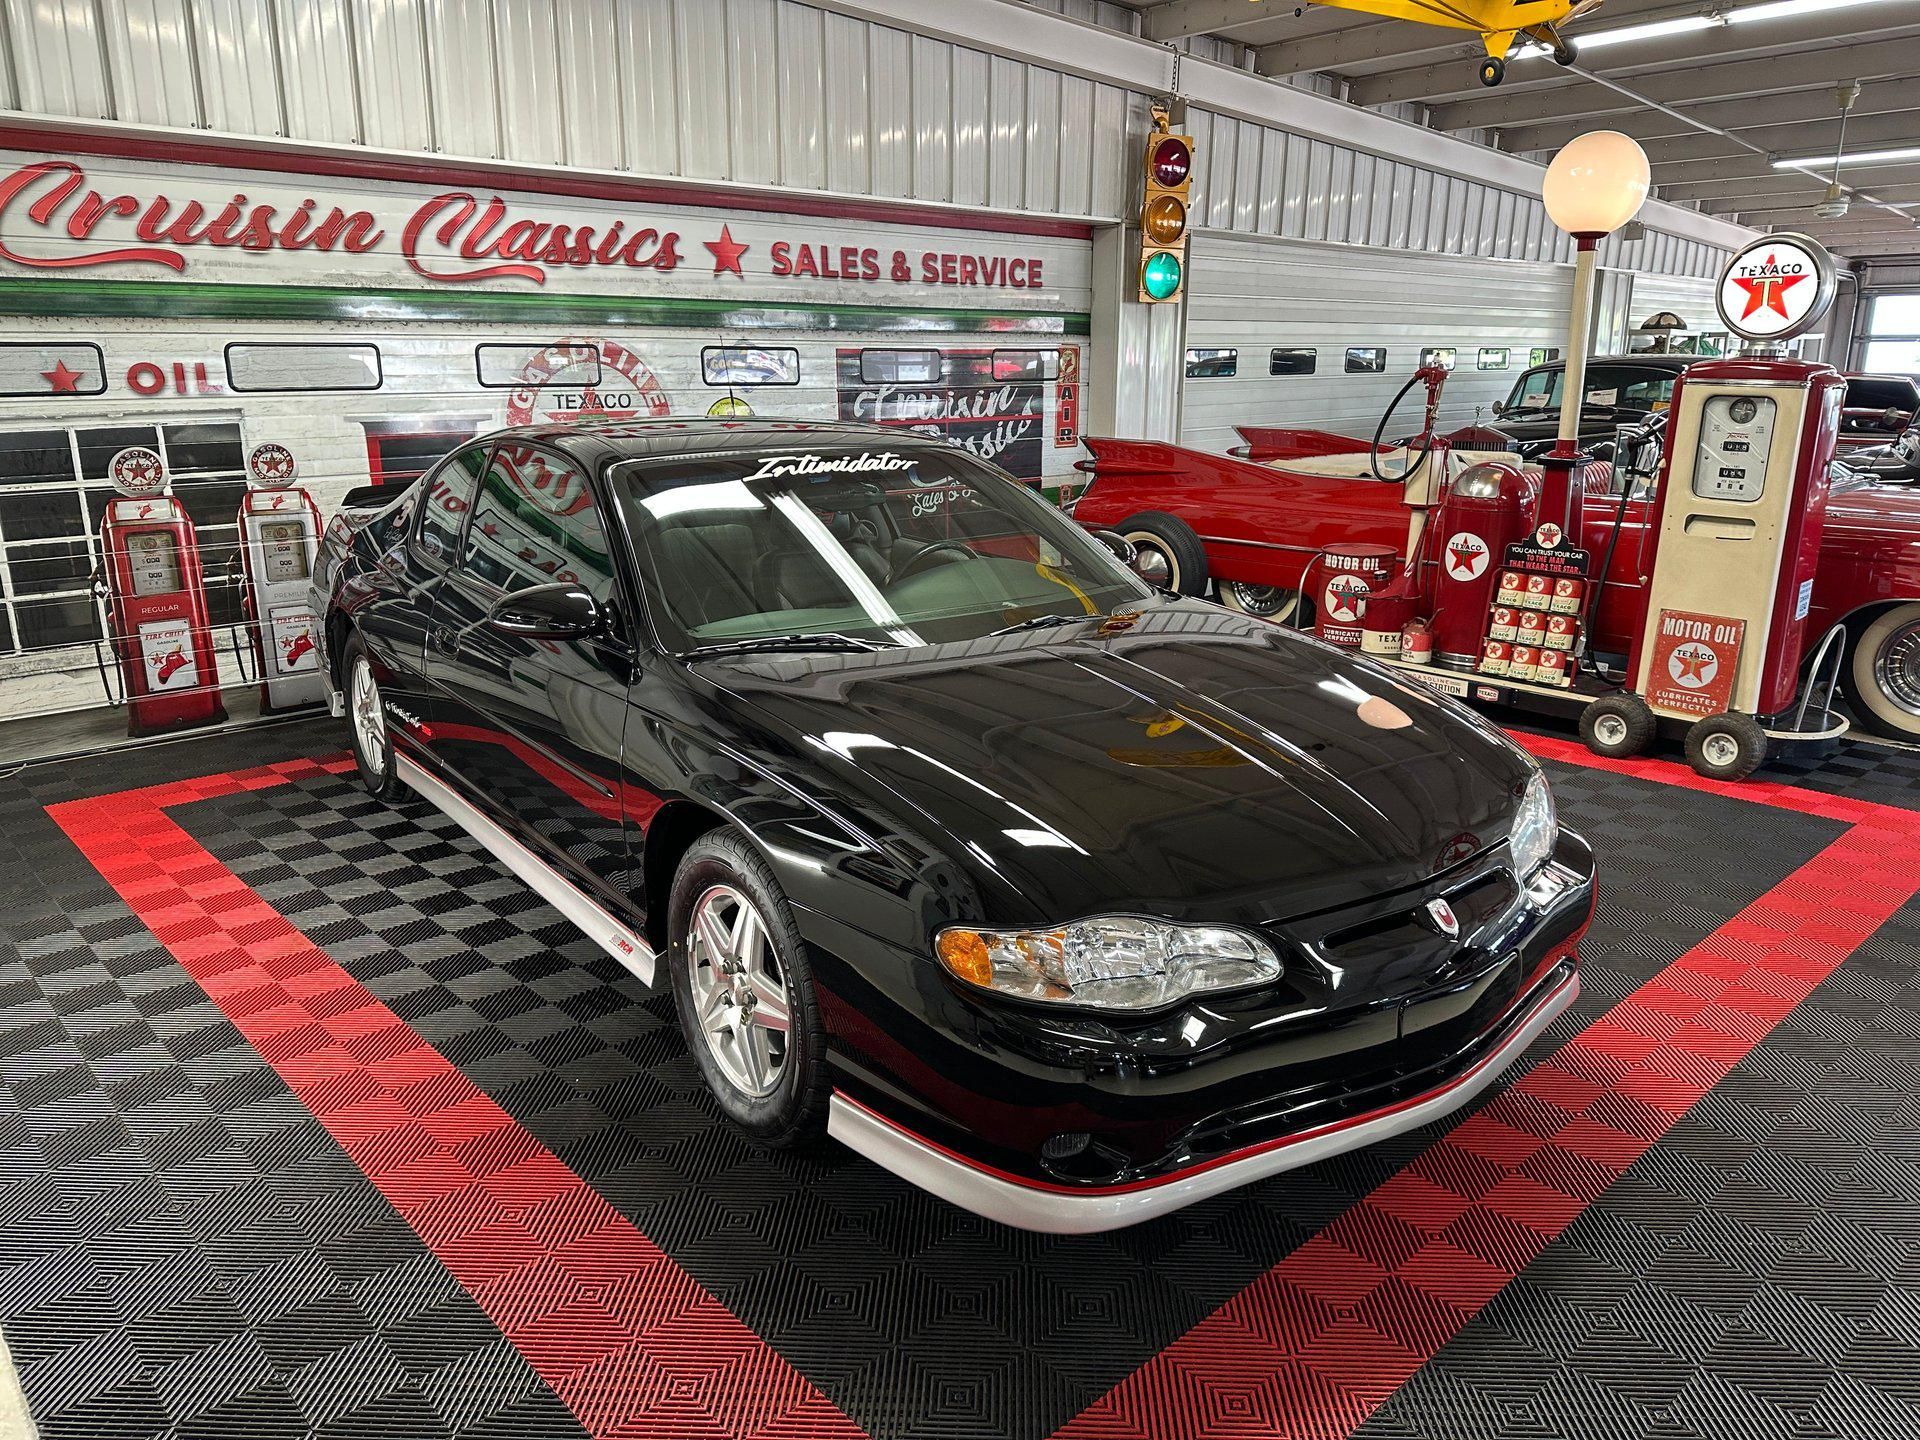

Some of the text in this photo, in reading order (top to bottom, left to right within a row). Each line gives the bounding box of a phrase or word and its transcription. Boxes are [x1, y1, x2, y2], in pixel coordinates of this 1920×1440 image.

[0, 161, 685, 286] Cruisin Classics
[770, 240, 1044, 288] SALES & SERVICE
[1740, 263, 1802, 277] TEXACO
[127, 361, 224, 395] OIL
[512, 336, 668, 410] GASOLINE
[552, 393, 632, 410] TEXACO
[742, 452, 919, 482] Intimidator
[1451, 542, 1482, 551] TEXACO
[1325, 554, 1379, 571] MOTOR OIL
[1510, 560, 1525, 568] THAT
[1526, 562, 1549, 571] WEARS
[1550, 564, 1562, 572] THE
[1536, 555, 1548, 563] THE
[1549, 557, 1565, 565] MAN
[1330, 583, 1367, 593] TEXACO
[141, 604, 180, 615] REGULAR
[145, 633, 163, 641] FIRE
[1323, 628, 1361, 638] LUBRICATE
[1662, 617, 1736, 645] MOTOR OIL
[1676, 649, 1715, 661] TEXACO
[1478, 689, 1497, 698] TEXACO
[1656, 690, 1717, 706] LUBRICATES
[1657, 699, 1713, 714] PERFECTLY
